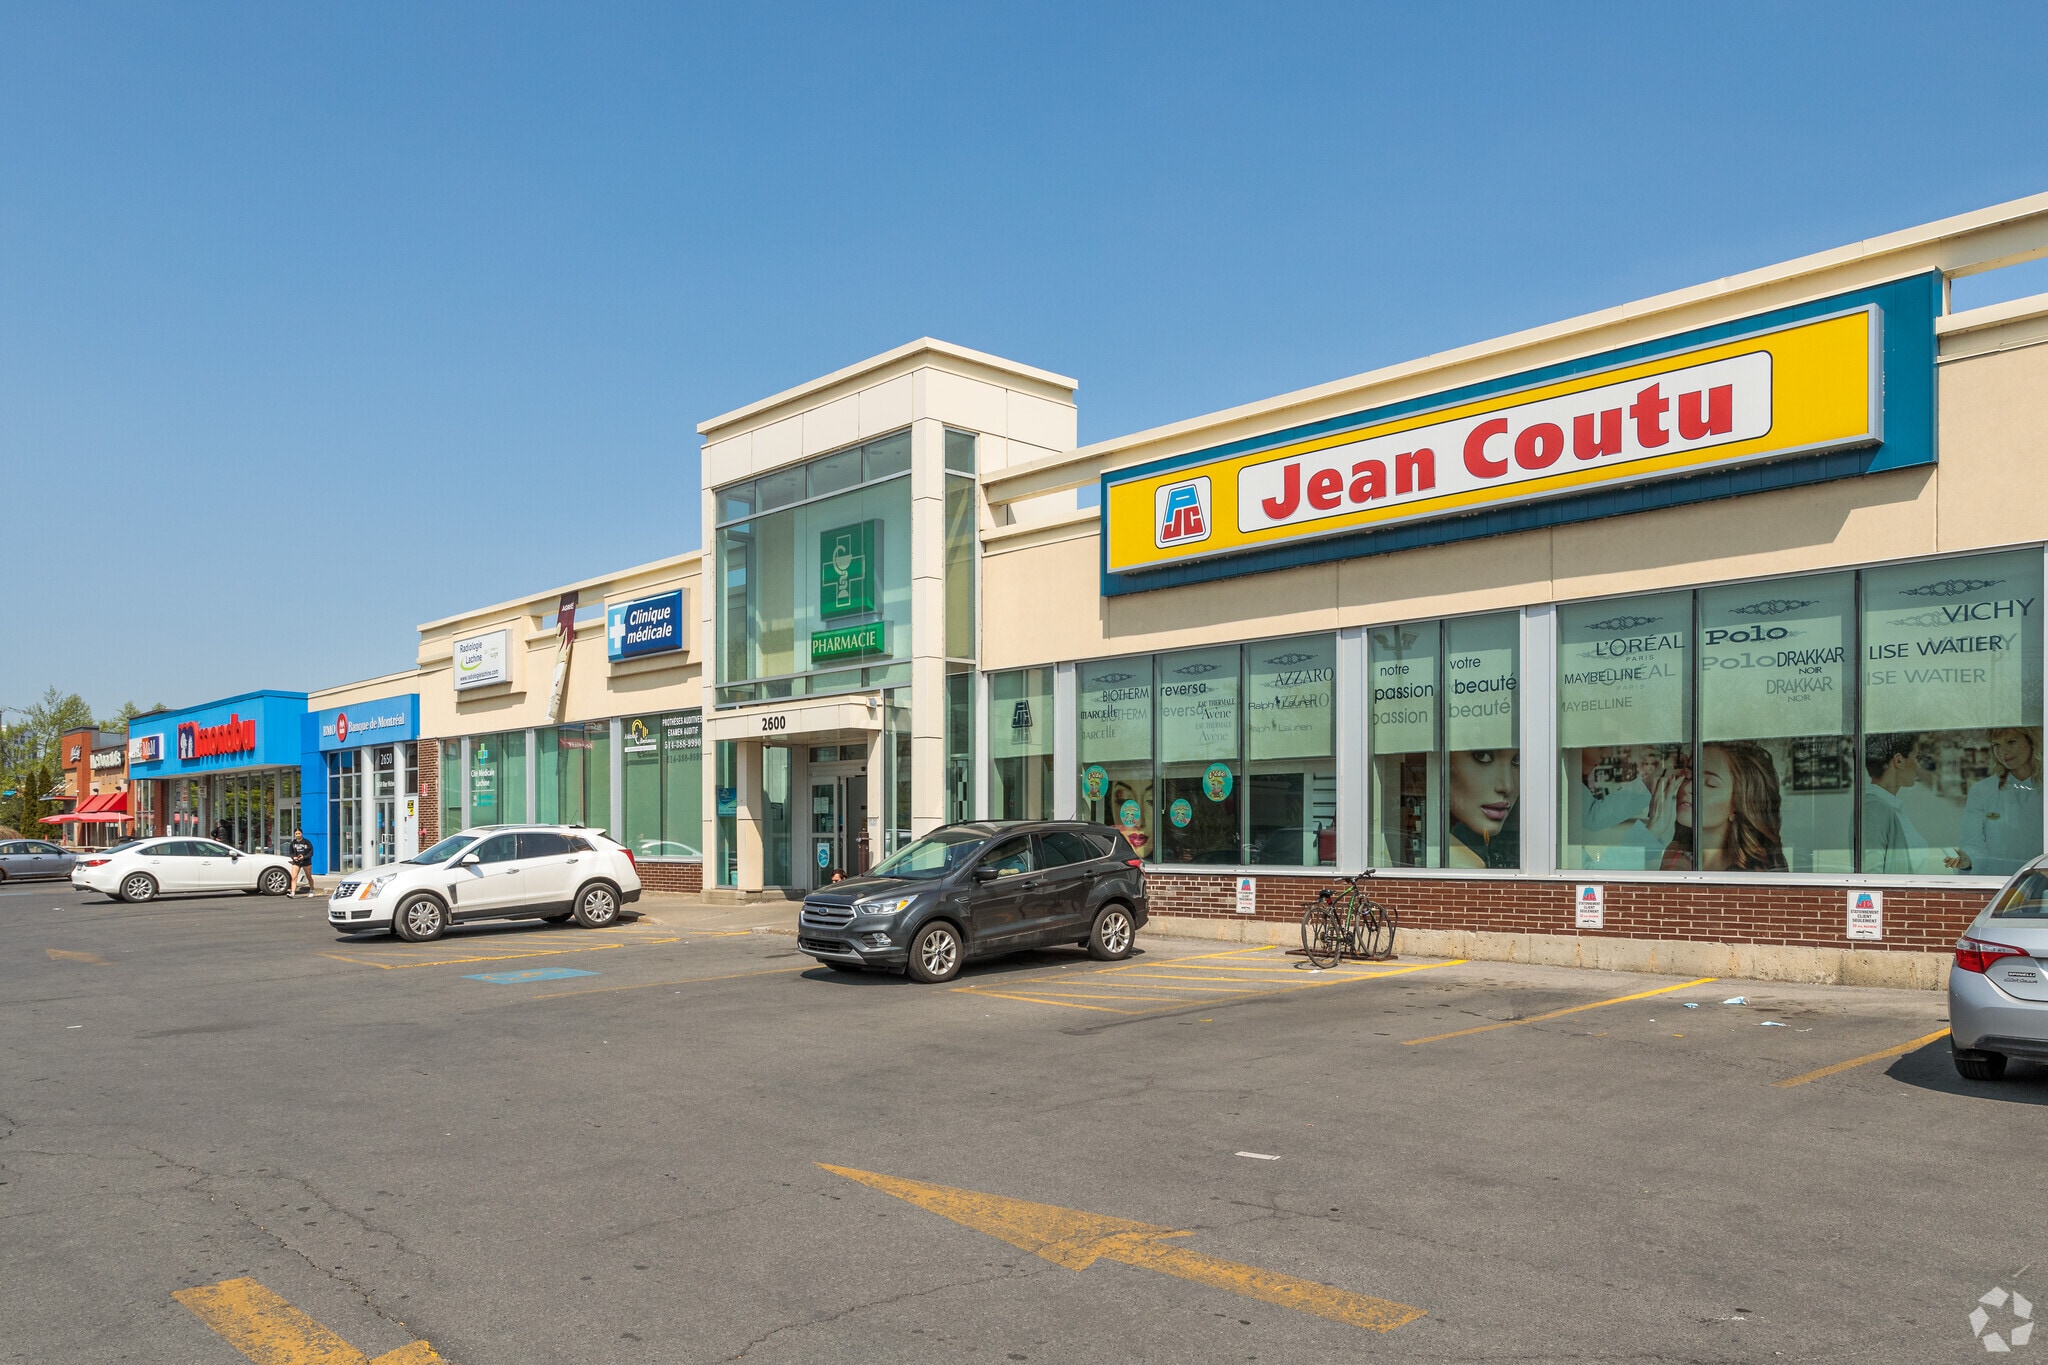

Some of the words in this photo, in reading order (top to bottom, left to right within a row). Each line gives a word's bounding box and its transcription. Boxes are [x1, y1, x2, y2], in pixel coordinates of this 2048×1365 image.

[1262, 447, 1436, 520] Jean
[1463, 382, 1733, 479] Coutu
[630, 607, 671, 625] Clinique
[1942, 598, 2035, 623] VICHY
[627, 622, 672, 644] médicale
[1705, 625, 1788, 645] Polo
[460, 641, 482, 653] Radiologie
[812, 631, 876, 654] PHARMACIE
[1596, 634, 1685, 656] L'ORÉAL
[1869, 643, 1909, 660] LISE
[1917, 635, 2003, 656] WATIER
[466, 655, 482, 664] Lachine
[1450, 657, 1481, 669] votre
[1777, 647, 1845, 667] DRAKKAR
[1274, 667, 1334, 686] AZZARO
[1380, 664, 1410, 676] notre
[1564, 668, 1642, 684] MAYBELLINE
[1160, 683, 1206, 696] reversa
[1454, 673, 1517, 694] beauté
[1102, 687, 1149, 702] BIOTHERM
[1374, 683, 1434, 704] passion
[1208, 698, 1235, 707] THERMALE
[1249, 702, 1274, 710] Ralph
[1283, 699, 1316, 708] Lauren
[1201, 707, 1231, 720] Avène
[323, 725, 336, 737] BMO
[348, 721, 369, 735] Banque
[370, 718, 377, 729] de
[378, 713, 405, 727] Montréal
[668, 728, 683, 737] EXAMEN
[684, 726, 699, 735] AUDITIF
[762, 716, 786, 731] 2600
[380, 753, 392, 765] 2650
